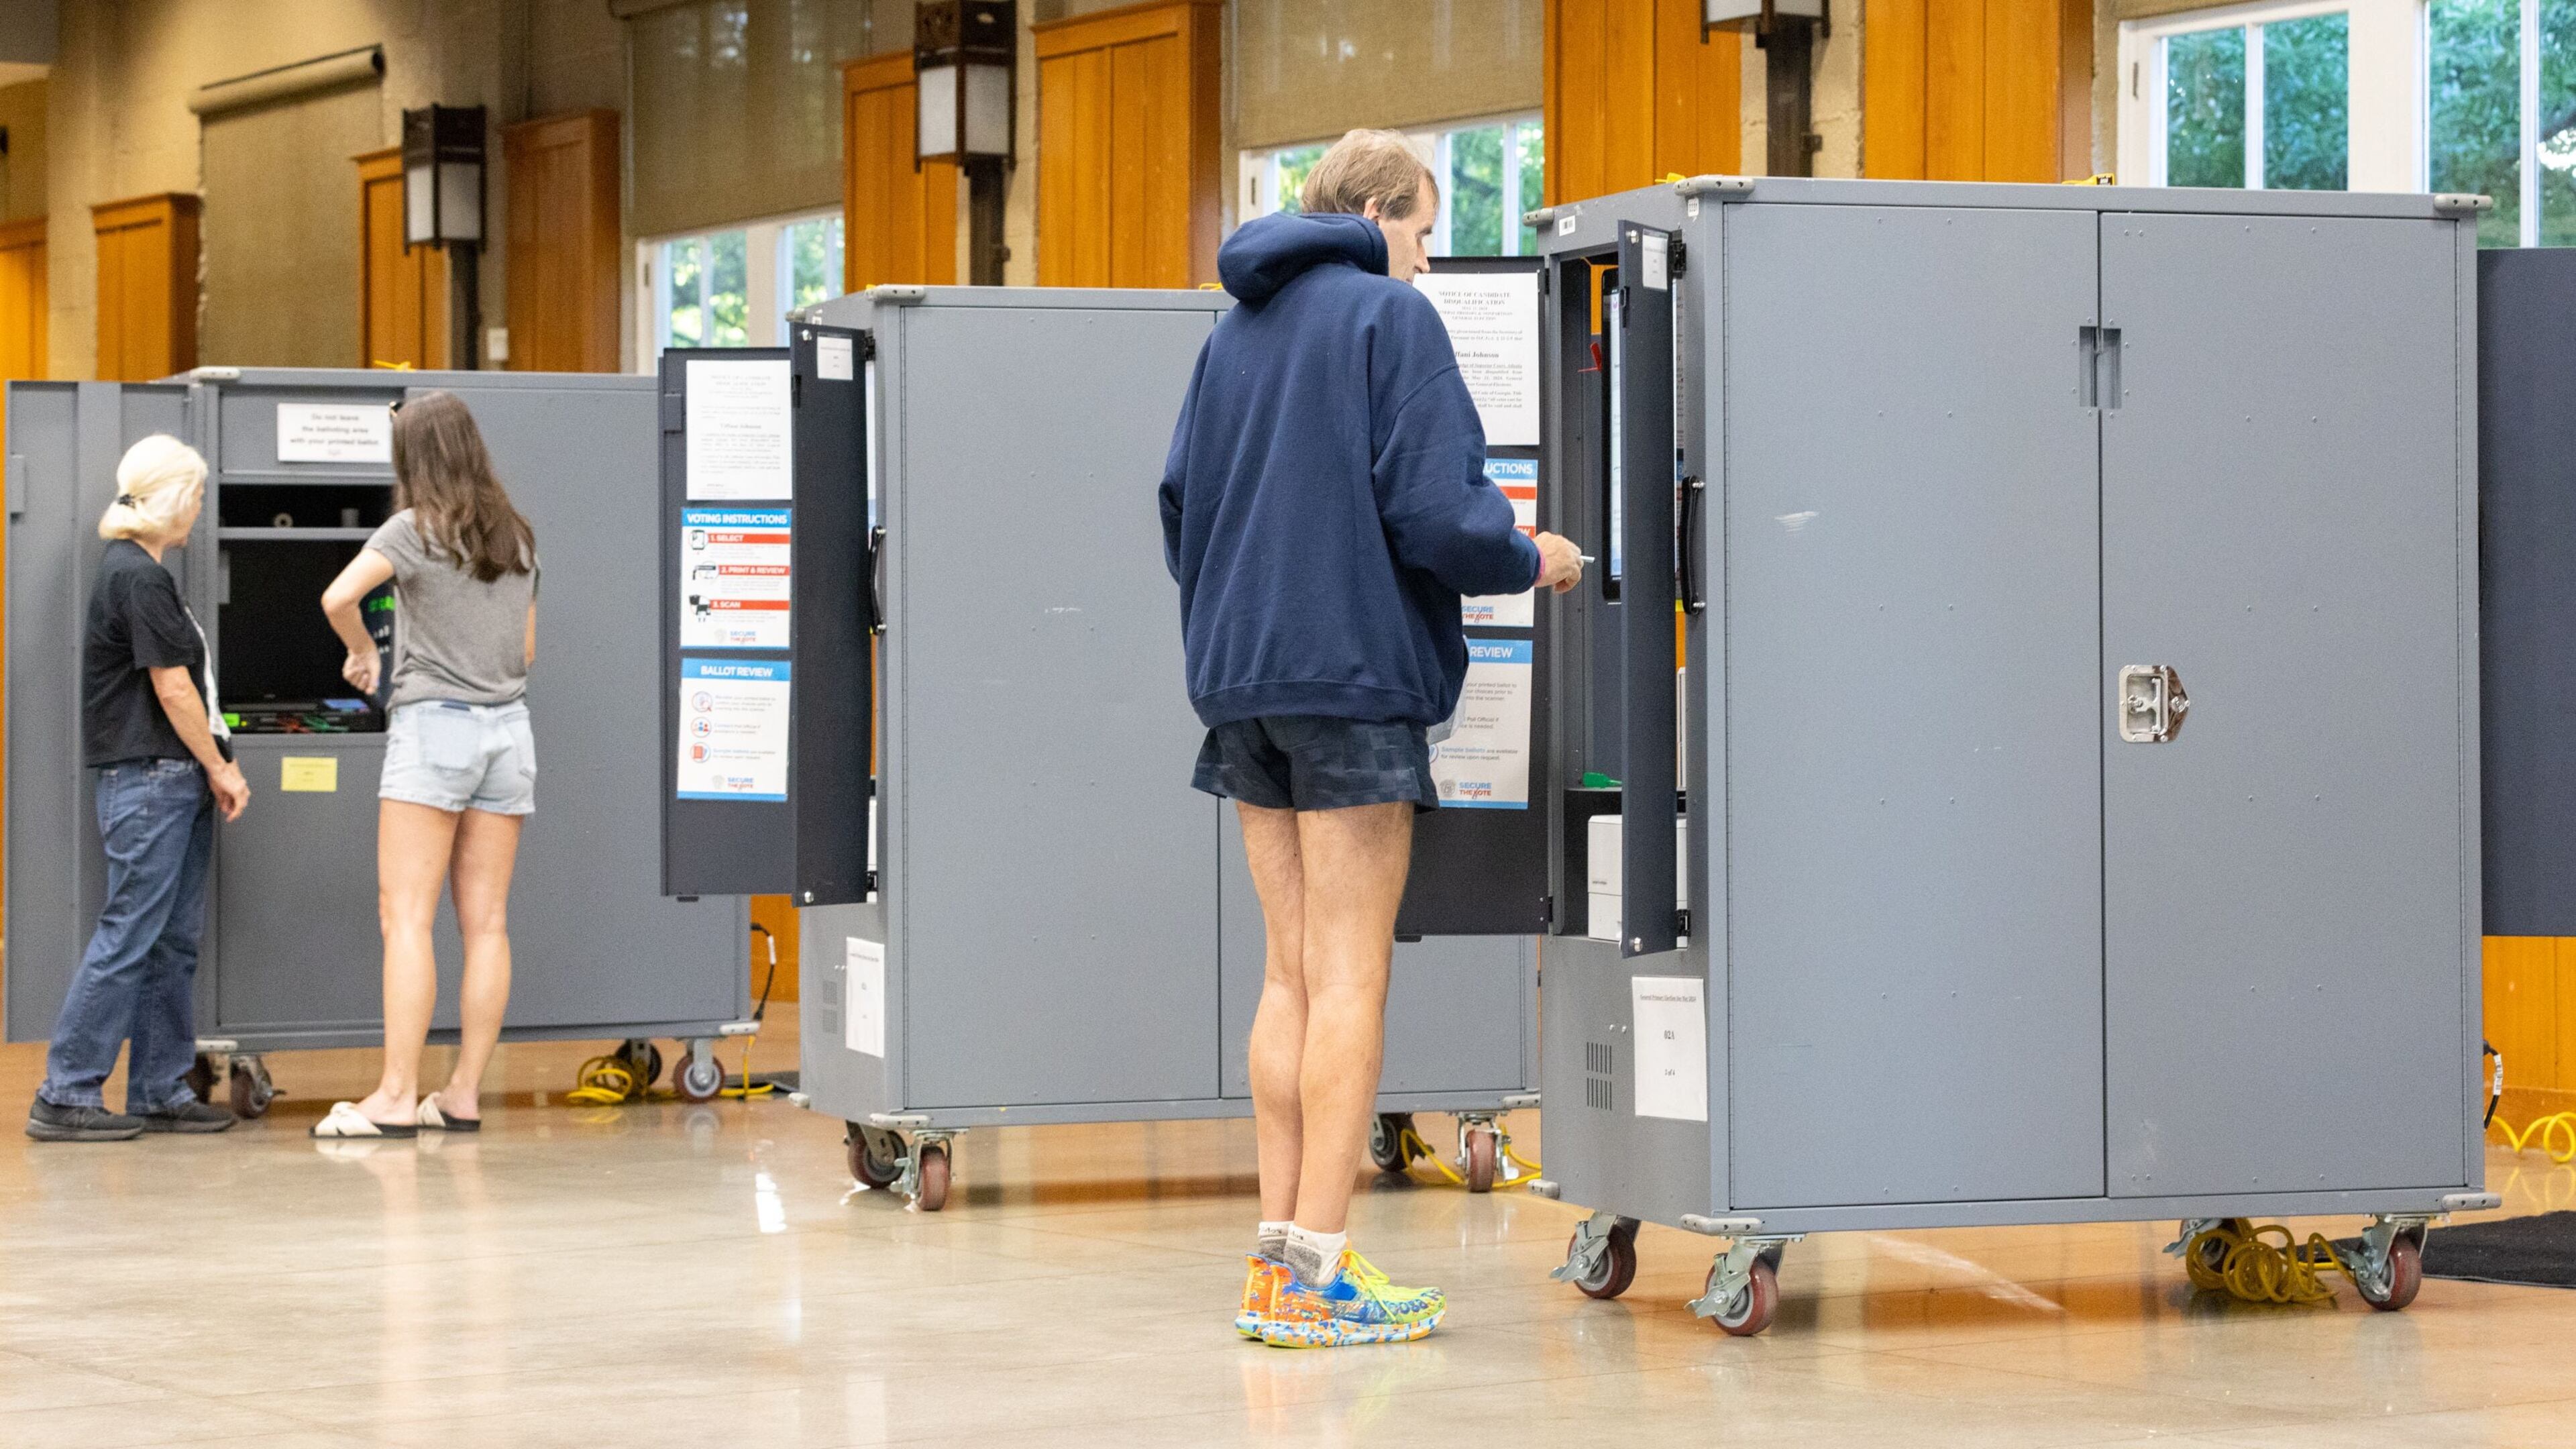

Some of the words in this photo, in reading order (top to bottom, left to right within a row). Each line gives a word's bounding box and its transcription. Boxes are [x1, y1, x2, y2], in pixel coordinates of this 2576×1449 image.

[327, 437, 355, 446] printed
[1484, 462, 1534, 475] UCTIONS
[687, 513, 721, 523] VOTING
[722, 514, 788, 524] INSTRUCTIONS
[1469, 646, 1513, 658] REVIEW
[700, 665, 735, 676] BALLOT
[737, 666, 773, 677] REVIEW
